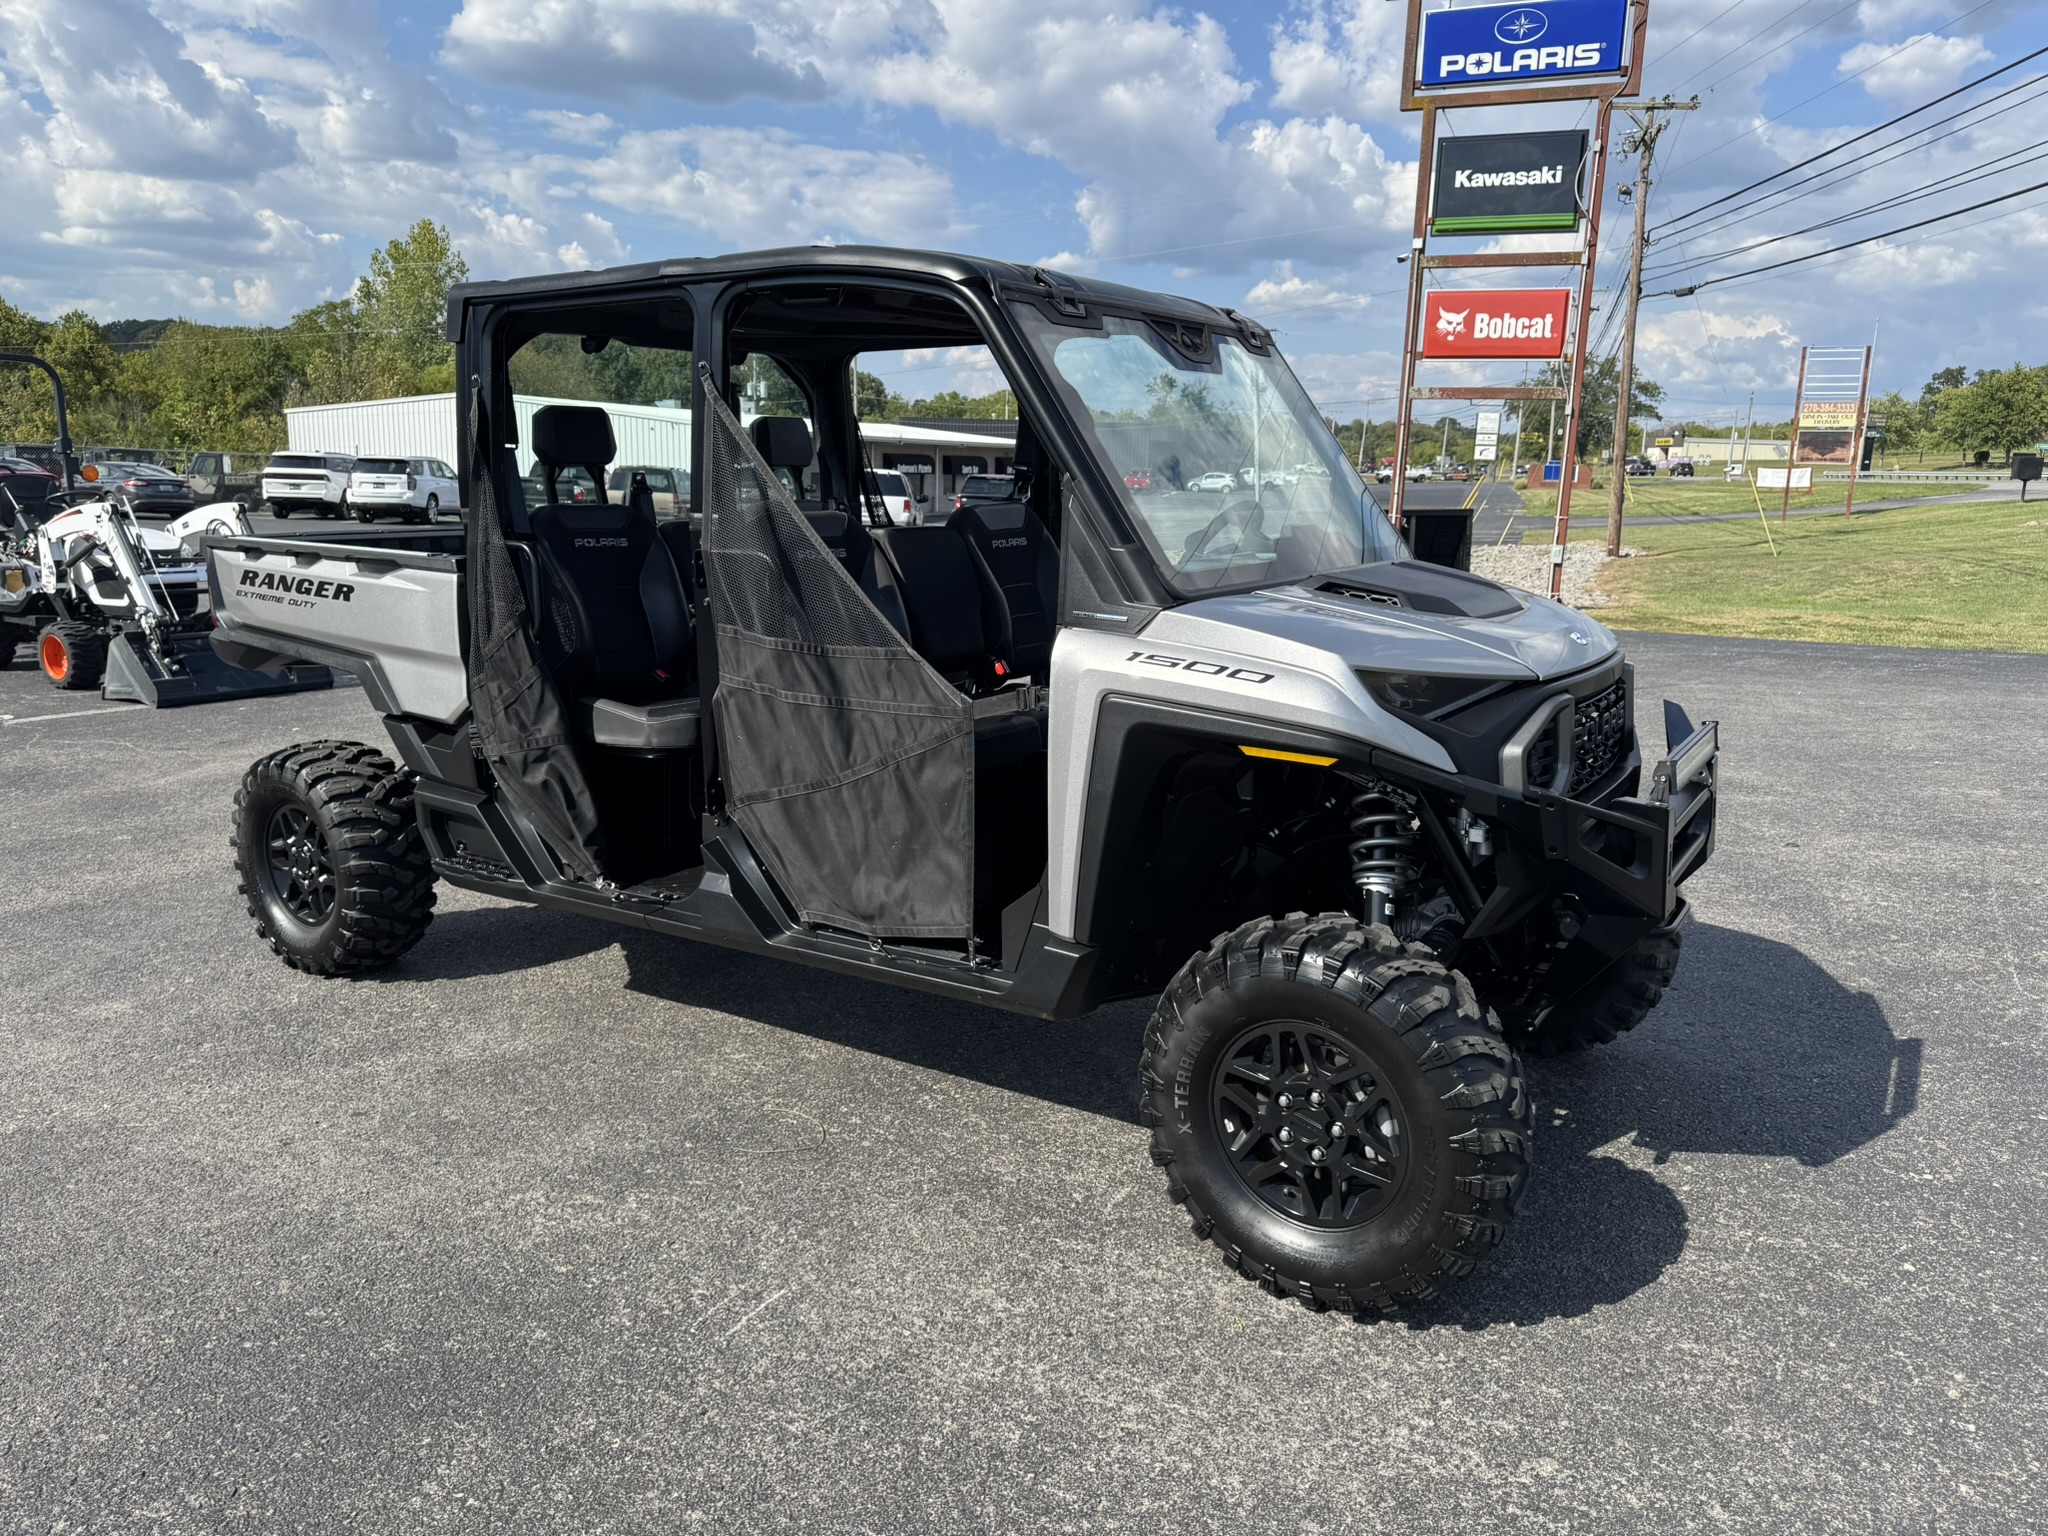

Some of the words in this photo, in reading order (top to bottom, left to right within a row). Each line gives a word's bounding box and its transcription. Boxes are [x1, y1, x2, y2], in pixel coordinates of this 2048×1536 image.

[1440, 43, 1600, 77] POLARIS
[1454, 165, 1563, 189] Kawasaki
[1473, 312, 1554, 339] Bobcat
[1803, 403, 1854, 412] 270-384-3333
[574, 537, 629, 548] POLARIS
[992, 537, 1028, 549] POLARIS
[239, 569, 355, 602] RANGER
[236, 589, 285, 604] EXTREME
[287, 598, 317, 609] DUTY
[1125, 651, 1276, 685] 1500
[1174, 1023, 1213, 1135] X-TERRAIN
